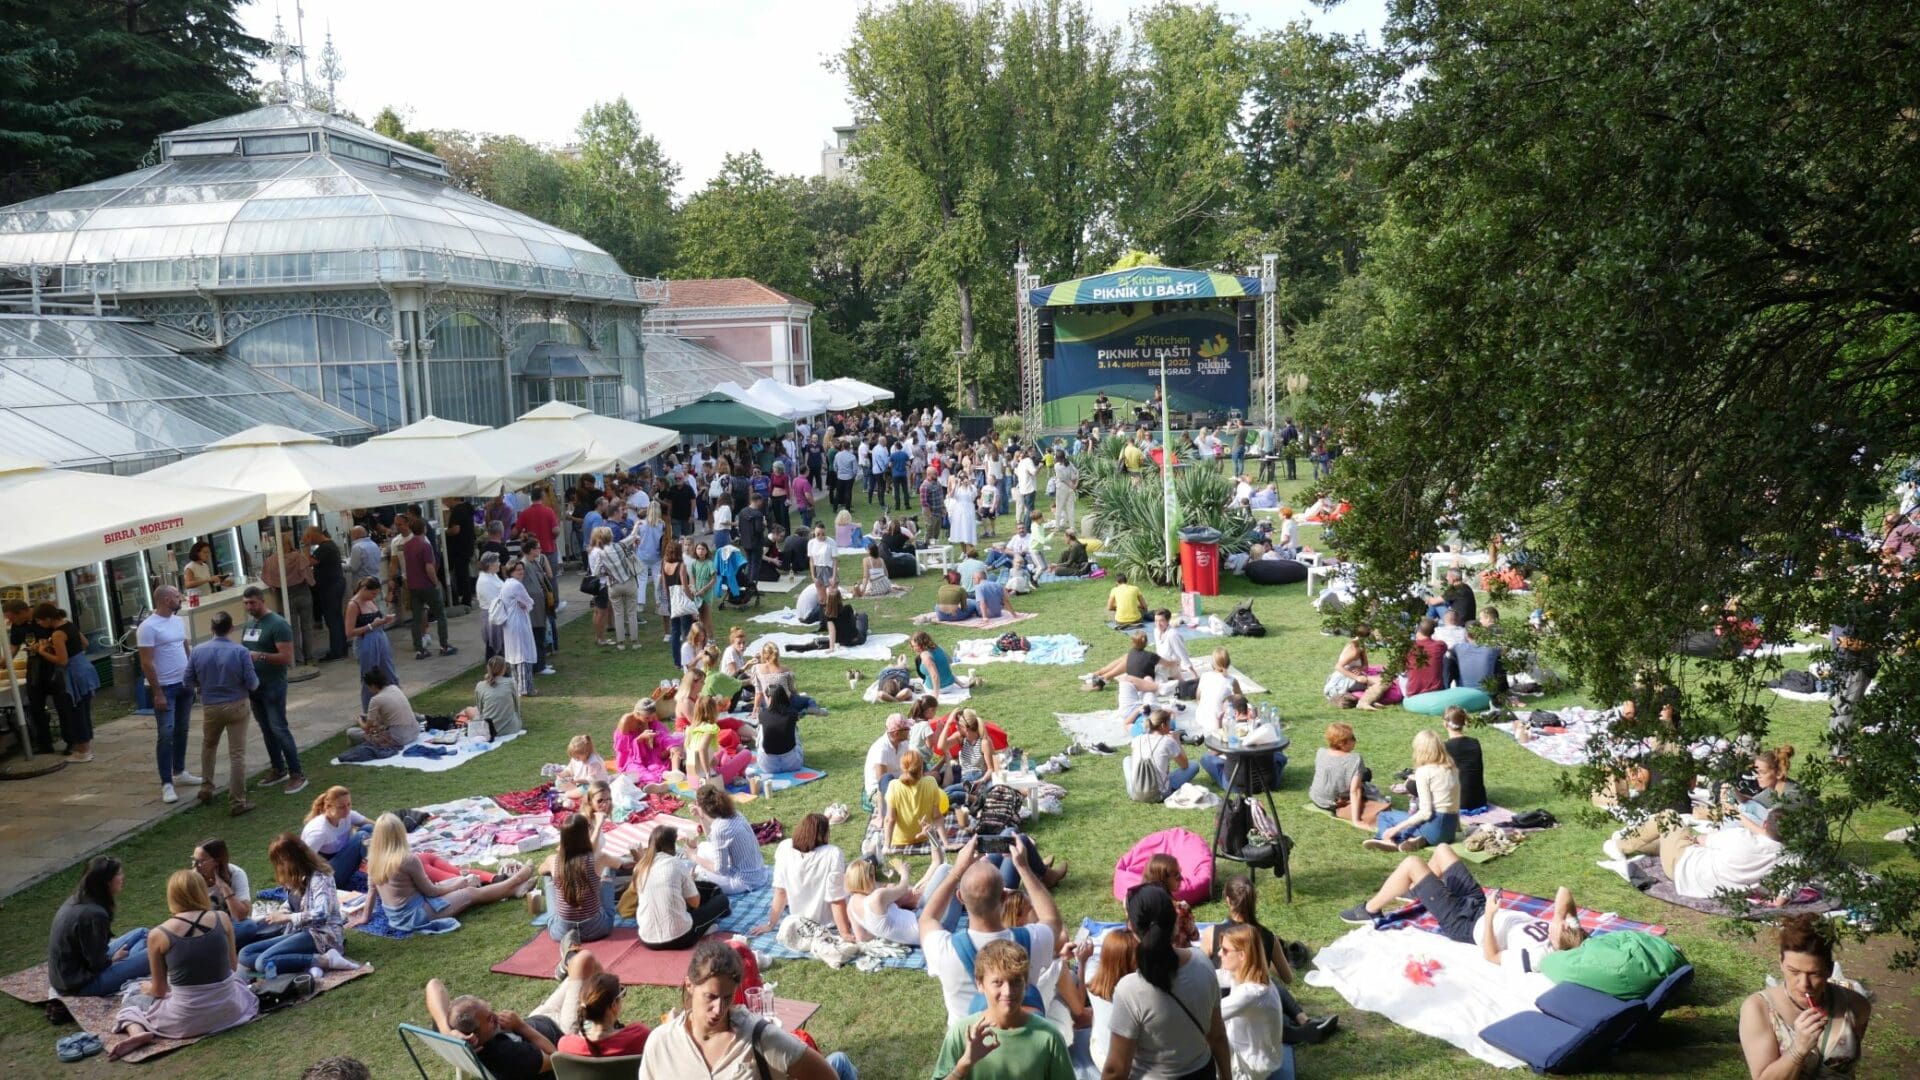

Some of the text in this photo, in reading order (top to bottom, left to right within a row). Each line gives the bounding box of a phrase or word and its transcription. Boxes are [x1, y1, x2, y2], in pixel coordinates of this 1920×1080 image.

[1093, 282, 1197, 299] PIKNIK U BAŠTI
[1098, 345, 1191, 360] PIKNIK U BAŠTI
[1148, 368, 1191, 376] BEGRAD
[104, 528, 136, 544] BIRRA
[139, 518, 184, 535] MORETTI
